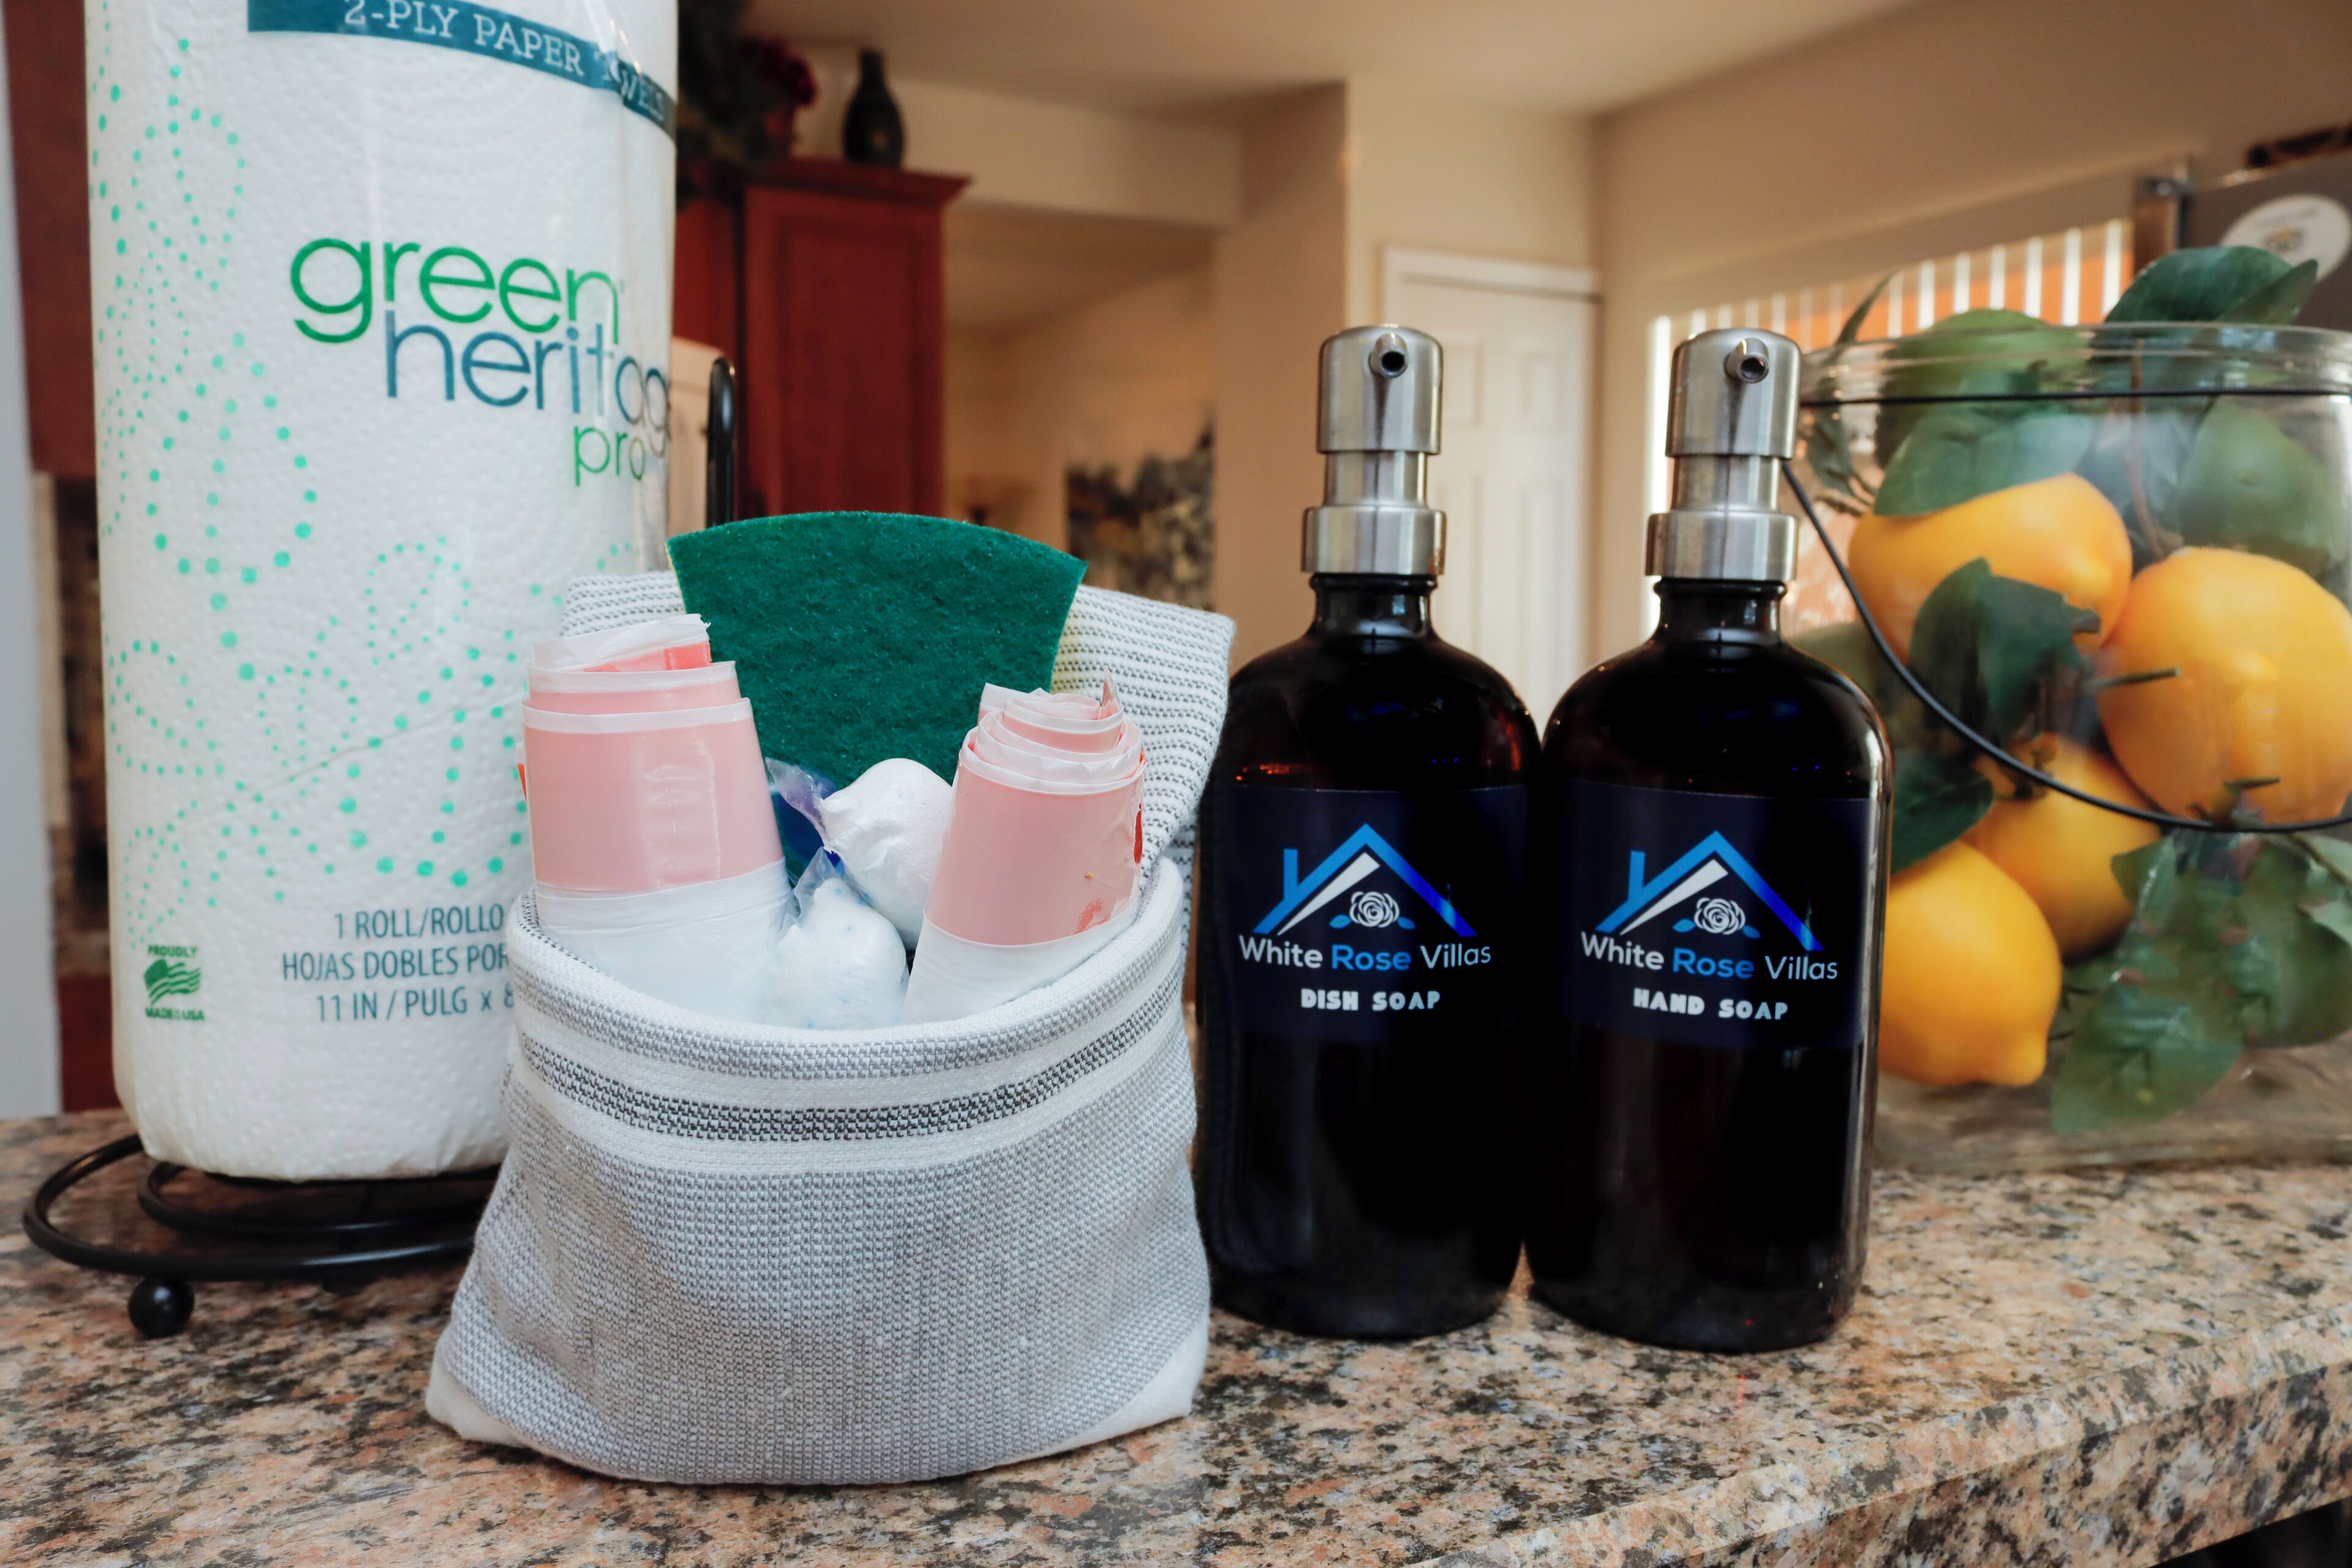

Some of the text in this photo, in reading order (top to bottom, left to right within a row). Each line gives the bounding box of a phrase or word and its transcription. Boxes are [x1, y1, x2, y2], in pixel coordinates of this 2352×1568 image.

[344, 0, 459, 39] 2-PLY
[473, 13, 585, 77] PAPER
[290, 238, 620, 345] green
[383, 309, 671, 458] heritag
[573, 426, 646, 488] pro
[334, 902, 505, 940] 1 ROLL/ROLLO
[147, 945, 197, 959] PROUDLY
[282, 942, 510, 981] HOJAS DOBLES POR
[1238, 935, 1491, 971] White Rose Villas
[1580, 931, 1839, 981] White Rose Villas
[181, 1009, 205, 1022] USA
[317, 993, 342, 1022] 11
[352, 991, 378, 1020] IN
[385, 990, 397, 1020] /
[404, 985, 468, 1017] PULG
[480, 989, 492, 1012] x
[1300, 987, 1441, 1012] DISH SOAP
[1633, 987, 1789, 1020] HAND SOAP
